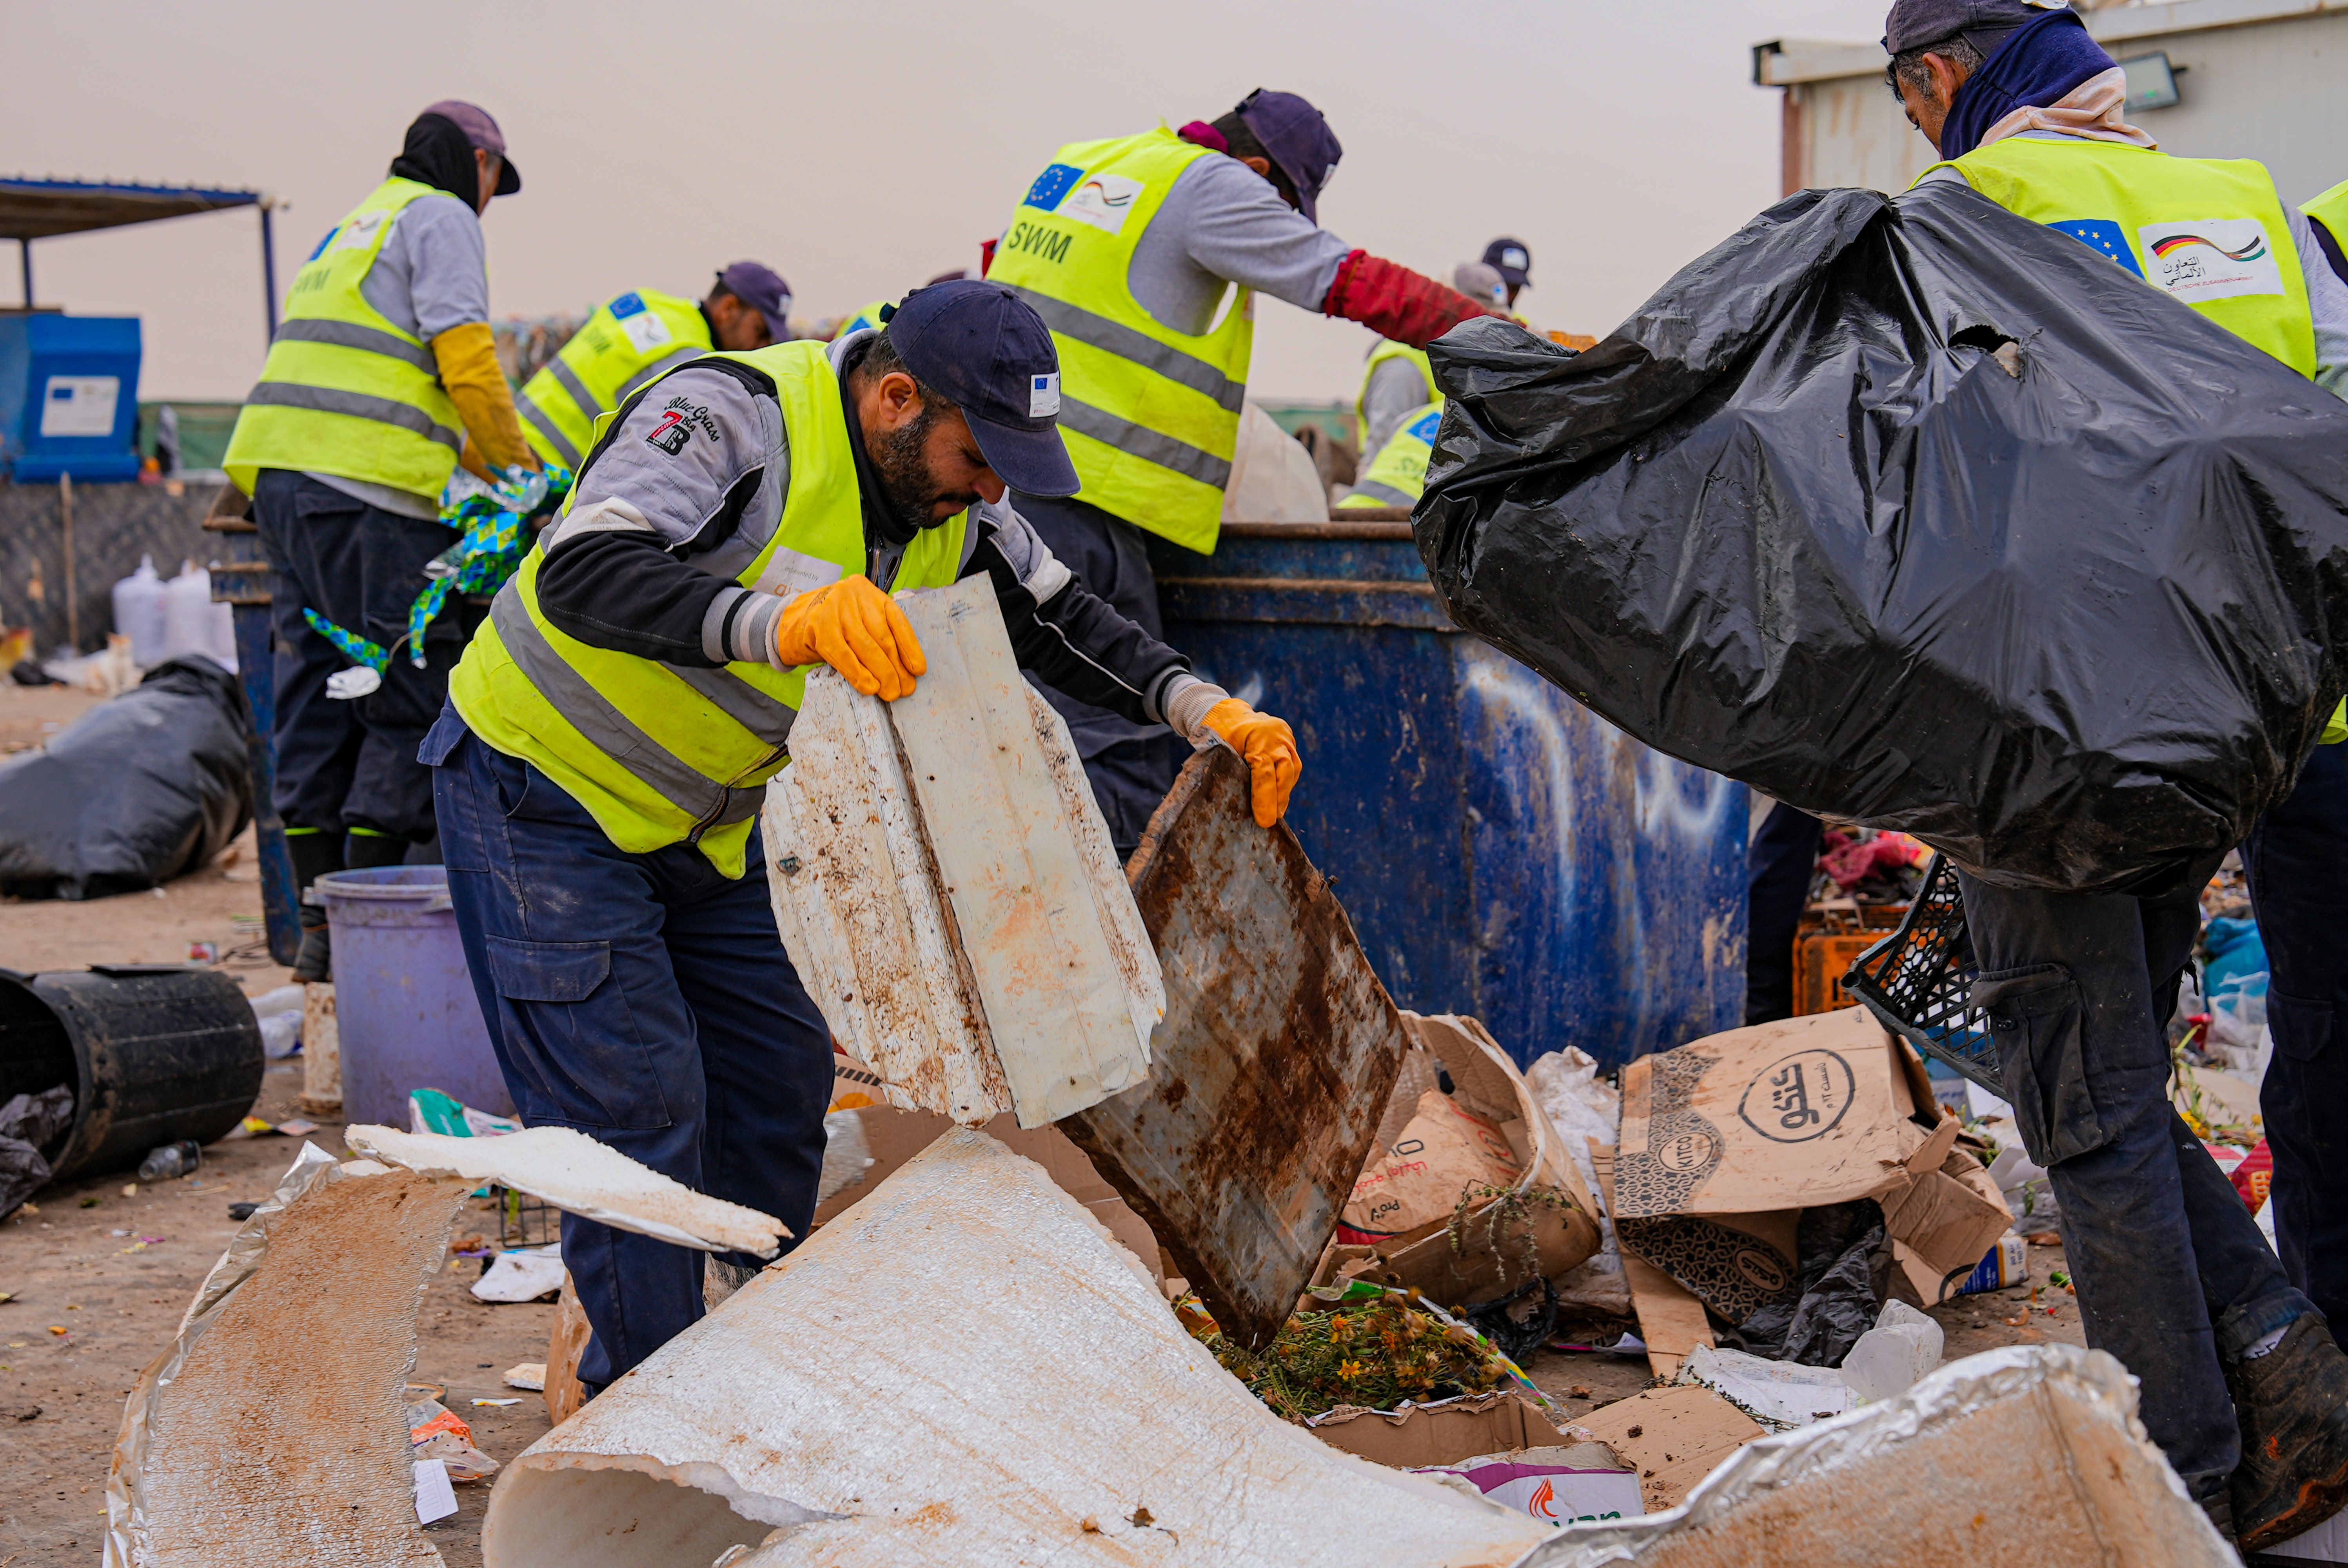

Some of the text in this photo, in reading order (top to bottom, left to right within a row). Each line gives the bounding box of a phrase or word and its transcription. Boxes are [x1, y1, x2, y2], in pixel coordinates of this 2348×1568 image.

[1009, 222, 1073, 264] SWM
[2163, 256, 2200, 273] التعاون
[2166, 266, 2206, 286] الألماني
[2168, 276, 2254, 292] DEUTSCHE ZUSAMMENARBEIT
[664, 396, 720, 442] Blue Grass
[1677, 1136, 1694, 1168] KITCO
